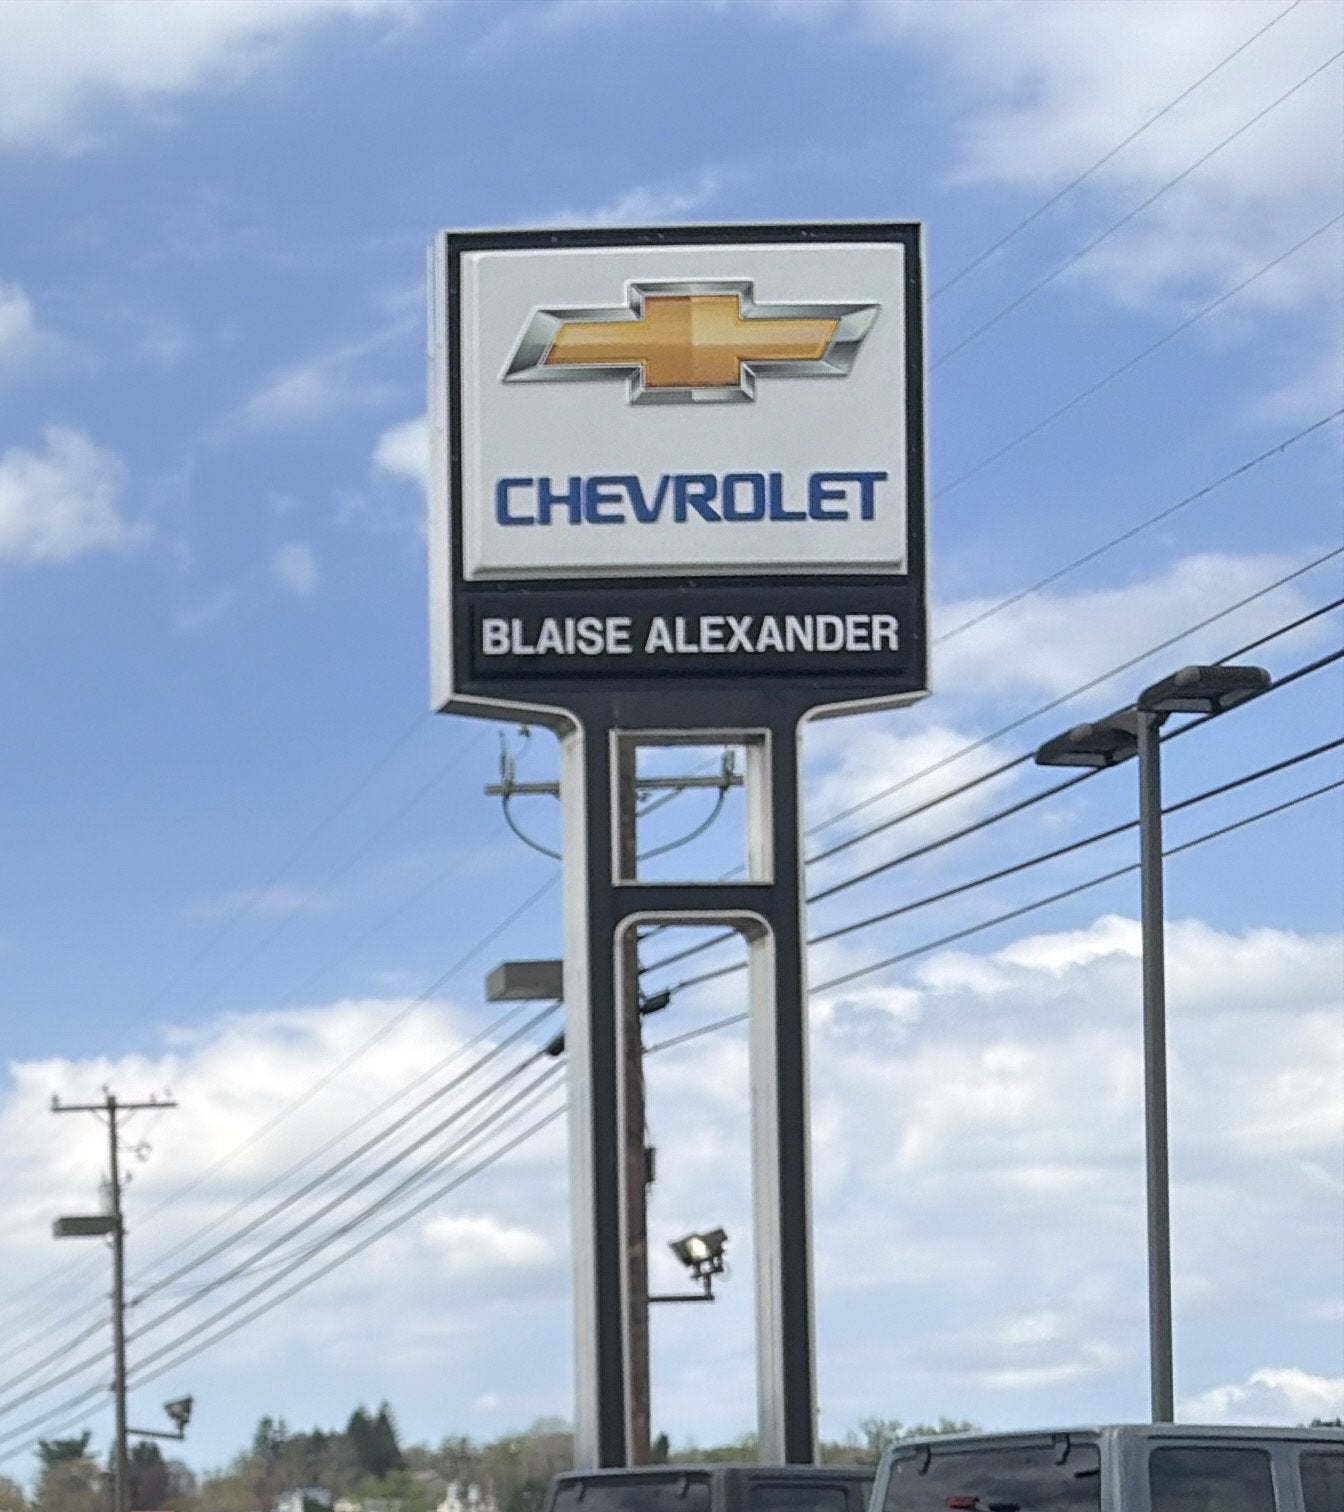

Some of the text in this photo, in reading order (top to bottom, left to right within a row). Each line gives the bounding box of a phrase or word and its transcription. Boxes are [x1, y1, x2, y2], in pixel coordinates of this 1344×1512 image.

[495, 471, 888, 525] CHEVROLET
[481, 614, 900, 655] BLAISE ALEXANDER
